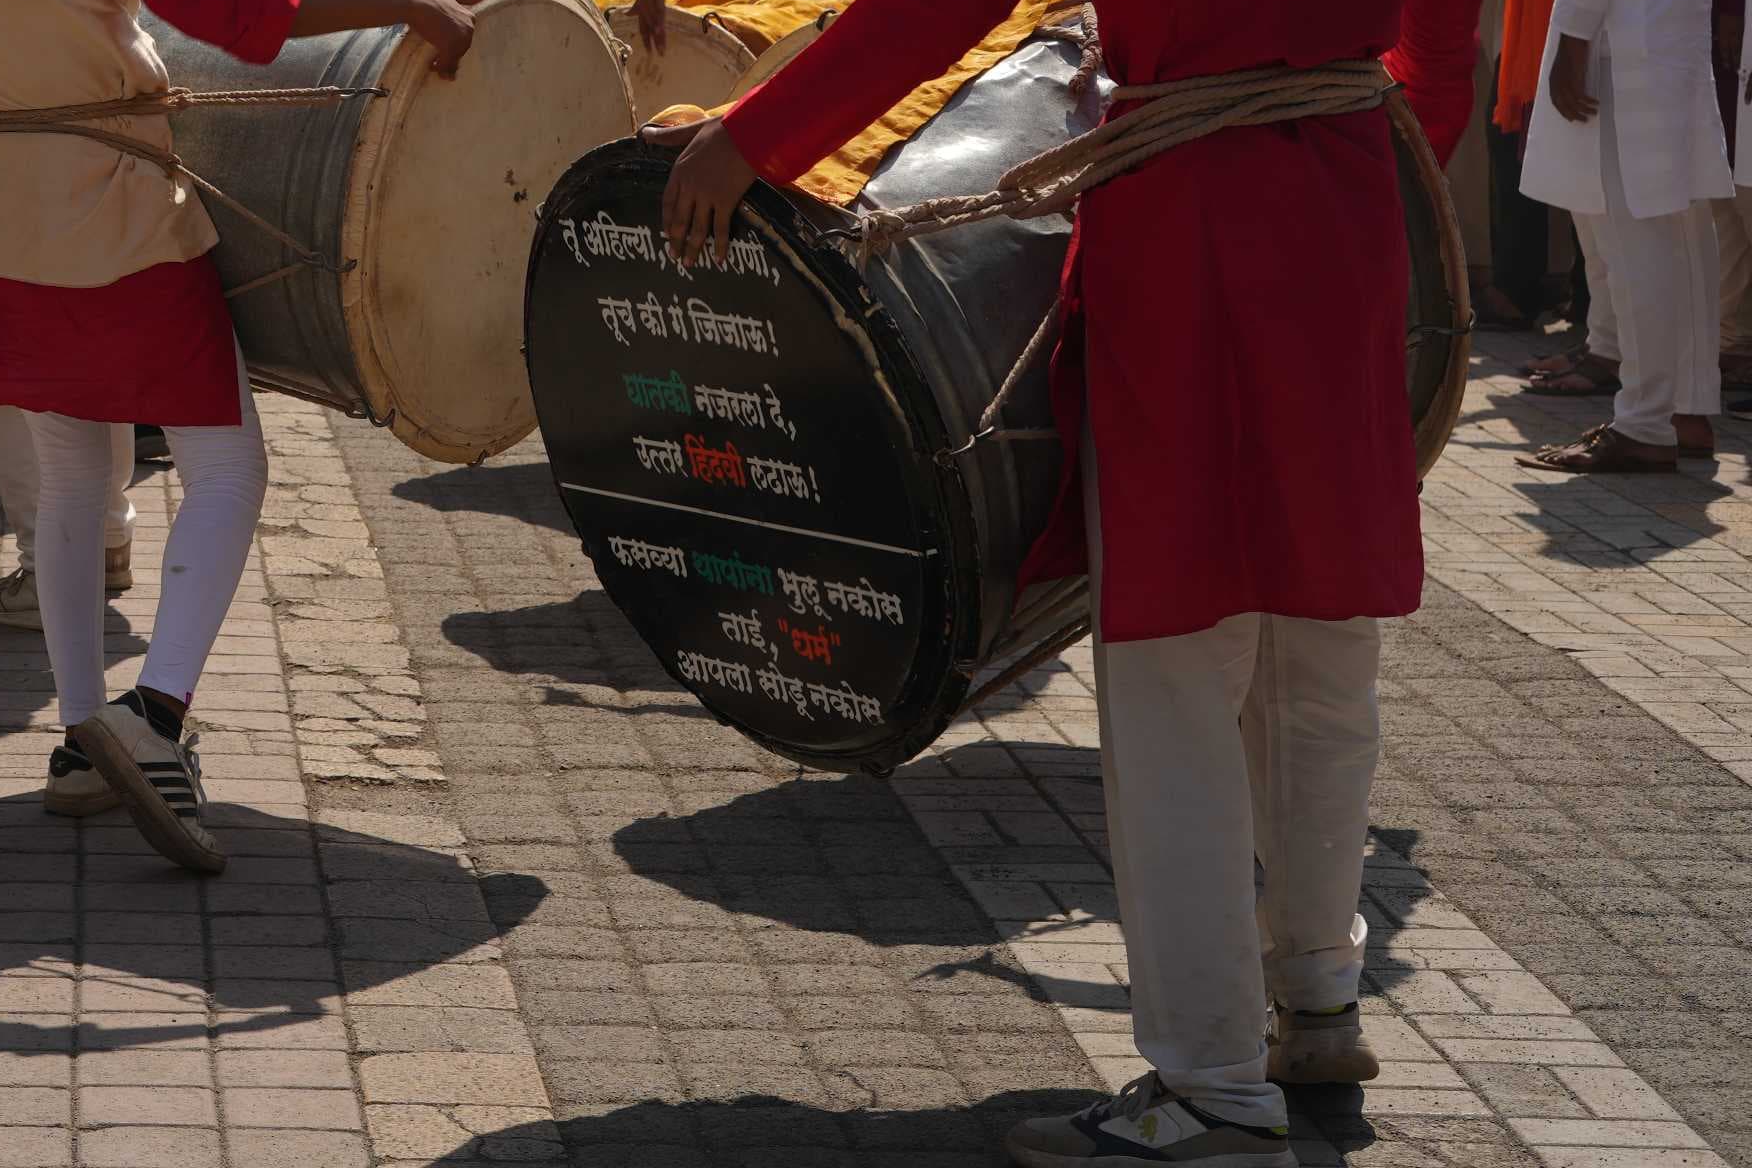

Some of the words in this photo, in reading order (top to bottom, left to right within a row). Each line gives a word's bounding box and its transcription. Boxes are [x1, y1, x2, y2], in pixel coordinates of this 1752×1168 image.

[558, 218, 591, 268] तू
[582, 210, 666, 271] अहिल्या,
[597, 296, 637, 347] तूच
[637, 291, 667, 339] की
[668, 293, 689, 343] गं
[686, 297, 780, 360] जिजाऊ!
[694, 384, 765, 430] नजरला
[763, 383, 797, 441] दे,
[632, 434, 689, 480] उत्तर
[683, 432, 747, 488] हिंदवी
[746, 456, 821, 504] लढाऊ!
[608, 535, 688, 579] फसव्या
[777, 567, 833, 622] भुलू
[823, 576, 905, 625] नकोस
[718, 609, 778, 662] ताई,
[676, 649, 753, 694] आपला
[755, 661, 815, 721] सोडू
[808, 680, 885, 725] नकोस
